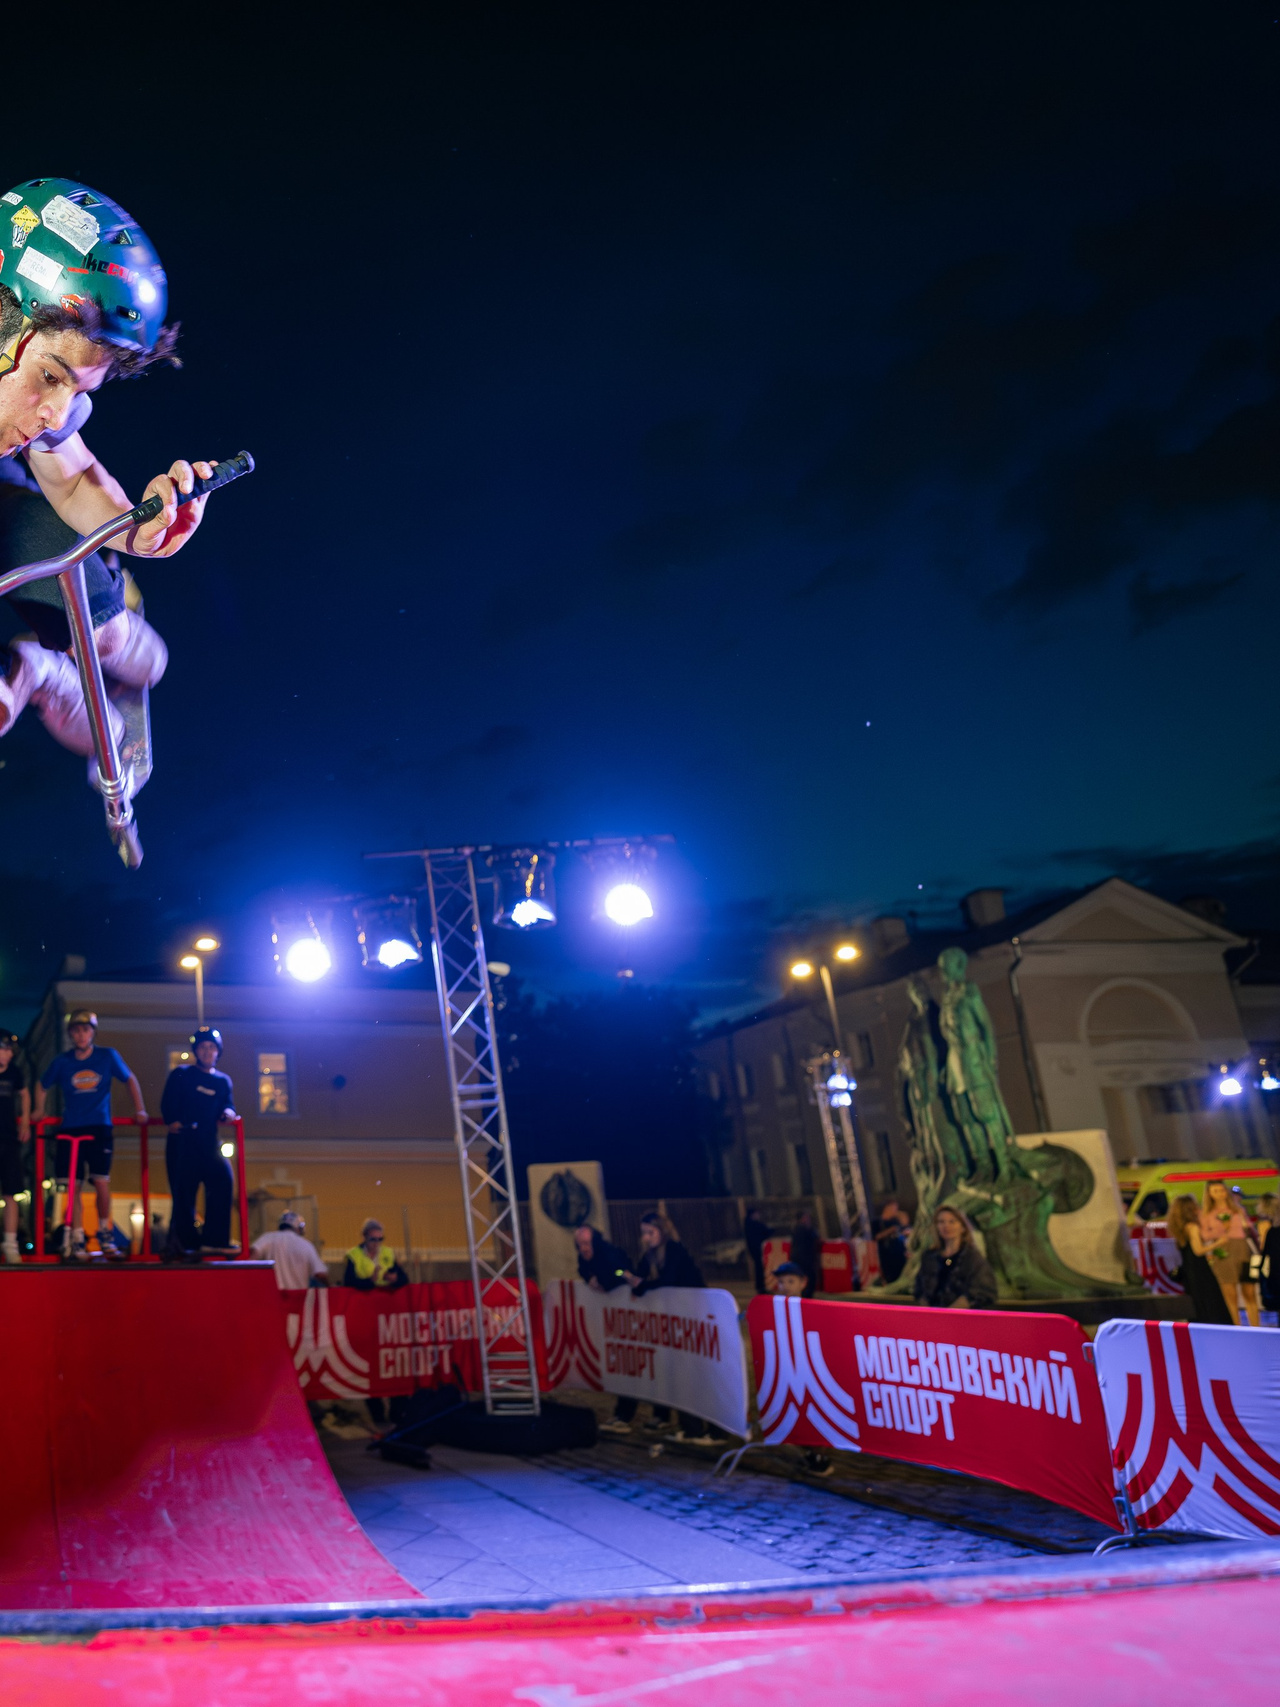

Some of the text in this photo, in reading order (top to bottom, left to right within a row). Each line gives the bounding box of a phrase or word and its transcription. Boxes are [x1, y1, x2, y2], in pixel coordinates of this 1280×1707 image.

[379, 1343, 453, 1379] СПОРТ
[603, 1306, 722, 1362] МОСКОВСКИЙ
[605, 1342, 657, 1381] СПОРТ
[854, 1334, 1082, 1425] МОСКОВСКИЙ
[861, 1381, 956, 1441] СПОРТ
